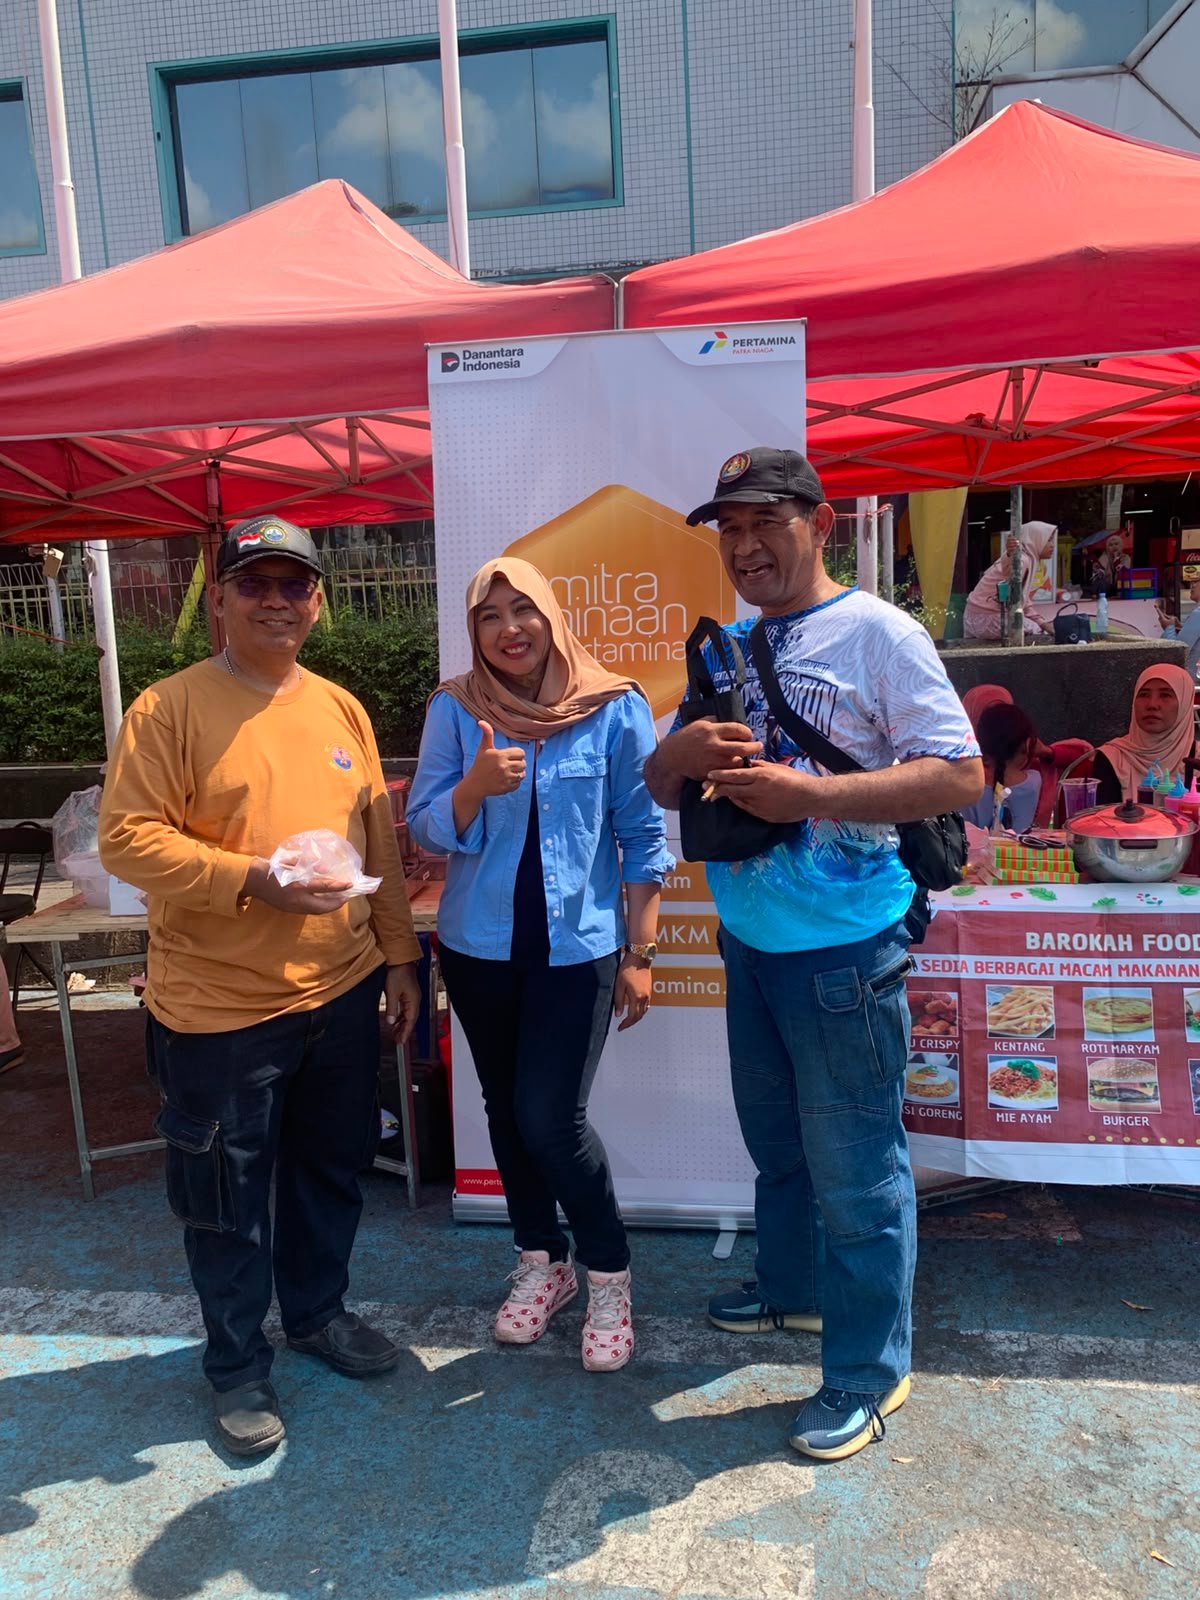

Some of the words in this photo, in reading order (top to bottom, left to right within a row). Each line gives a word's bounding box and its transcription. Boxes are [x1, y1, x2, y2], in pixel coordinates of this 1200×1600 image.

[732, 336, 796, 348] PERTAMINA
[462, 347, 524, 360] Danantara
[462, 358, 521, 372] Indonesia
[550, 563, 658, 606] mitra
[1025, 931, 1133, 952] BAROKAH
[921, 959, 968, 973] SEDIA
[974, 961, 1054, 976] BERBAGAI
[1059, 963, 1112, 977] MACAM
[1117, 964, 1200, 977] MAKANAN
[919, 1039, 961, 1050] CRISPY
[994, 1042, 1046, 1052] KENTANG
[1081, 1043, 1108, 1053] ROTI
[1111, 1045, 1160, 1054] MARYAM
[918, 1107, 963, 1120] GORENG
[996, 1113, 1016, 1123] MIE
[1020, 1113, 1052, 1124] AYAM
[1103, 1115, 1150, 1126] BURGER
